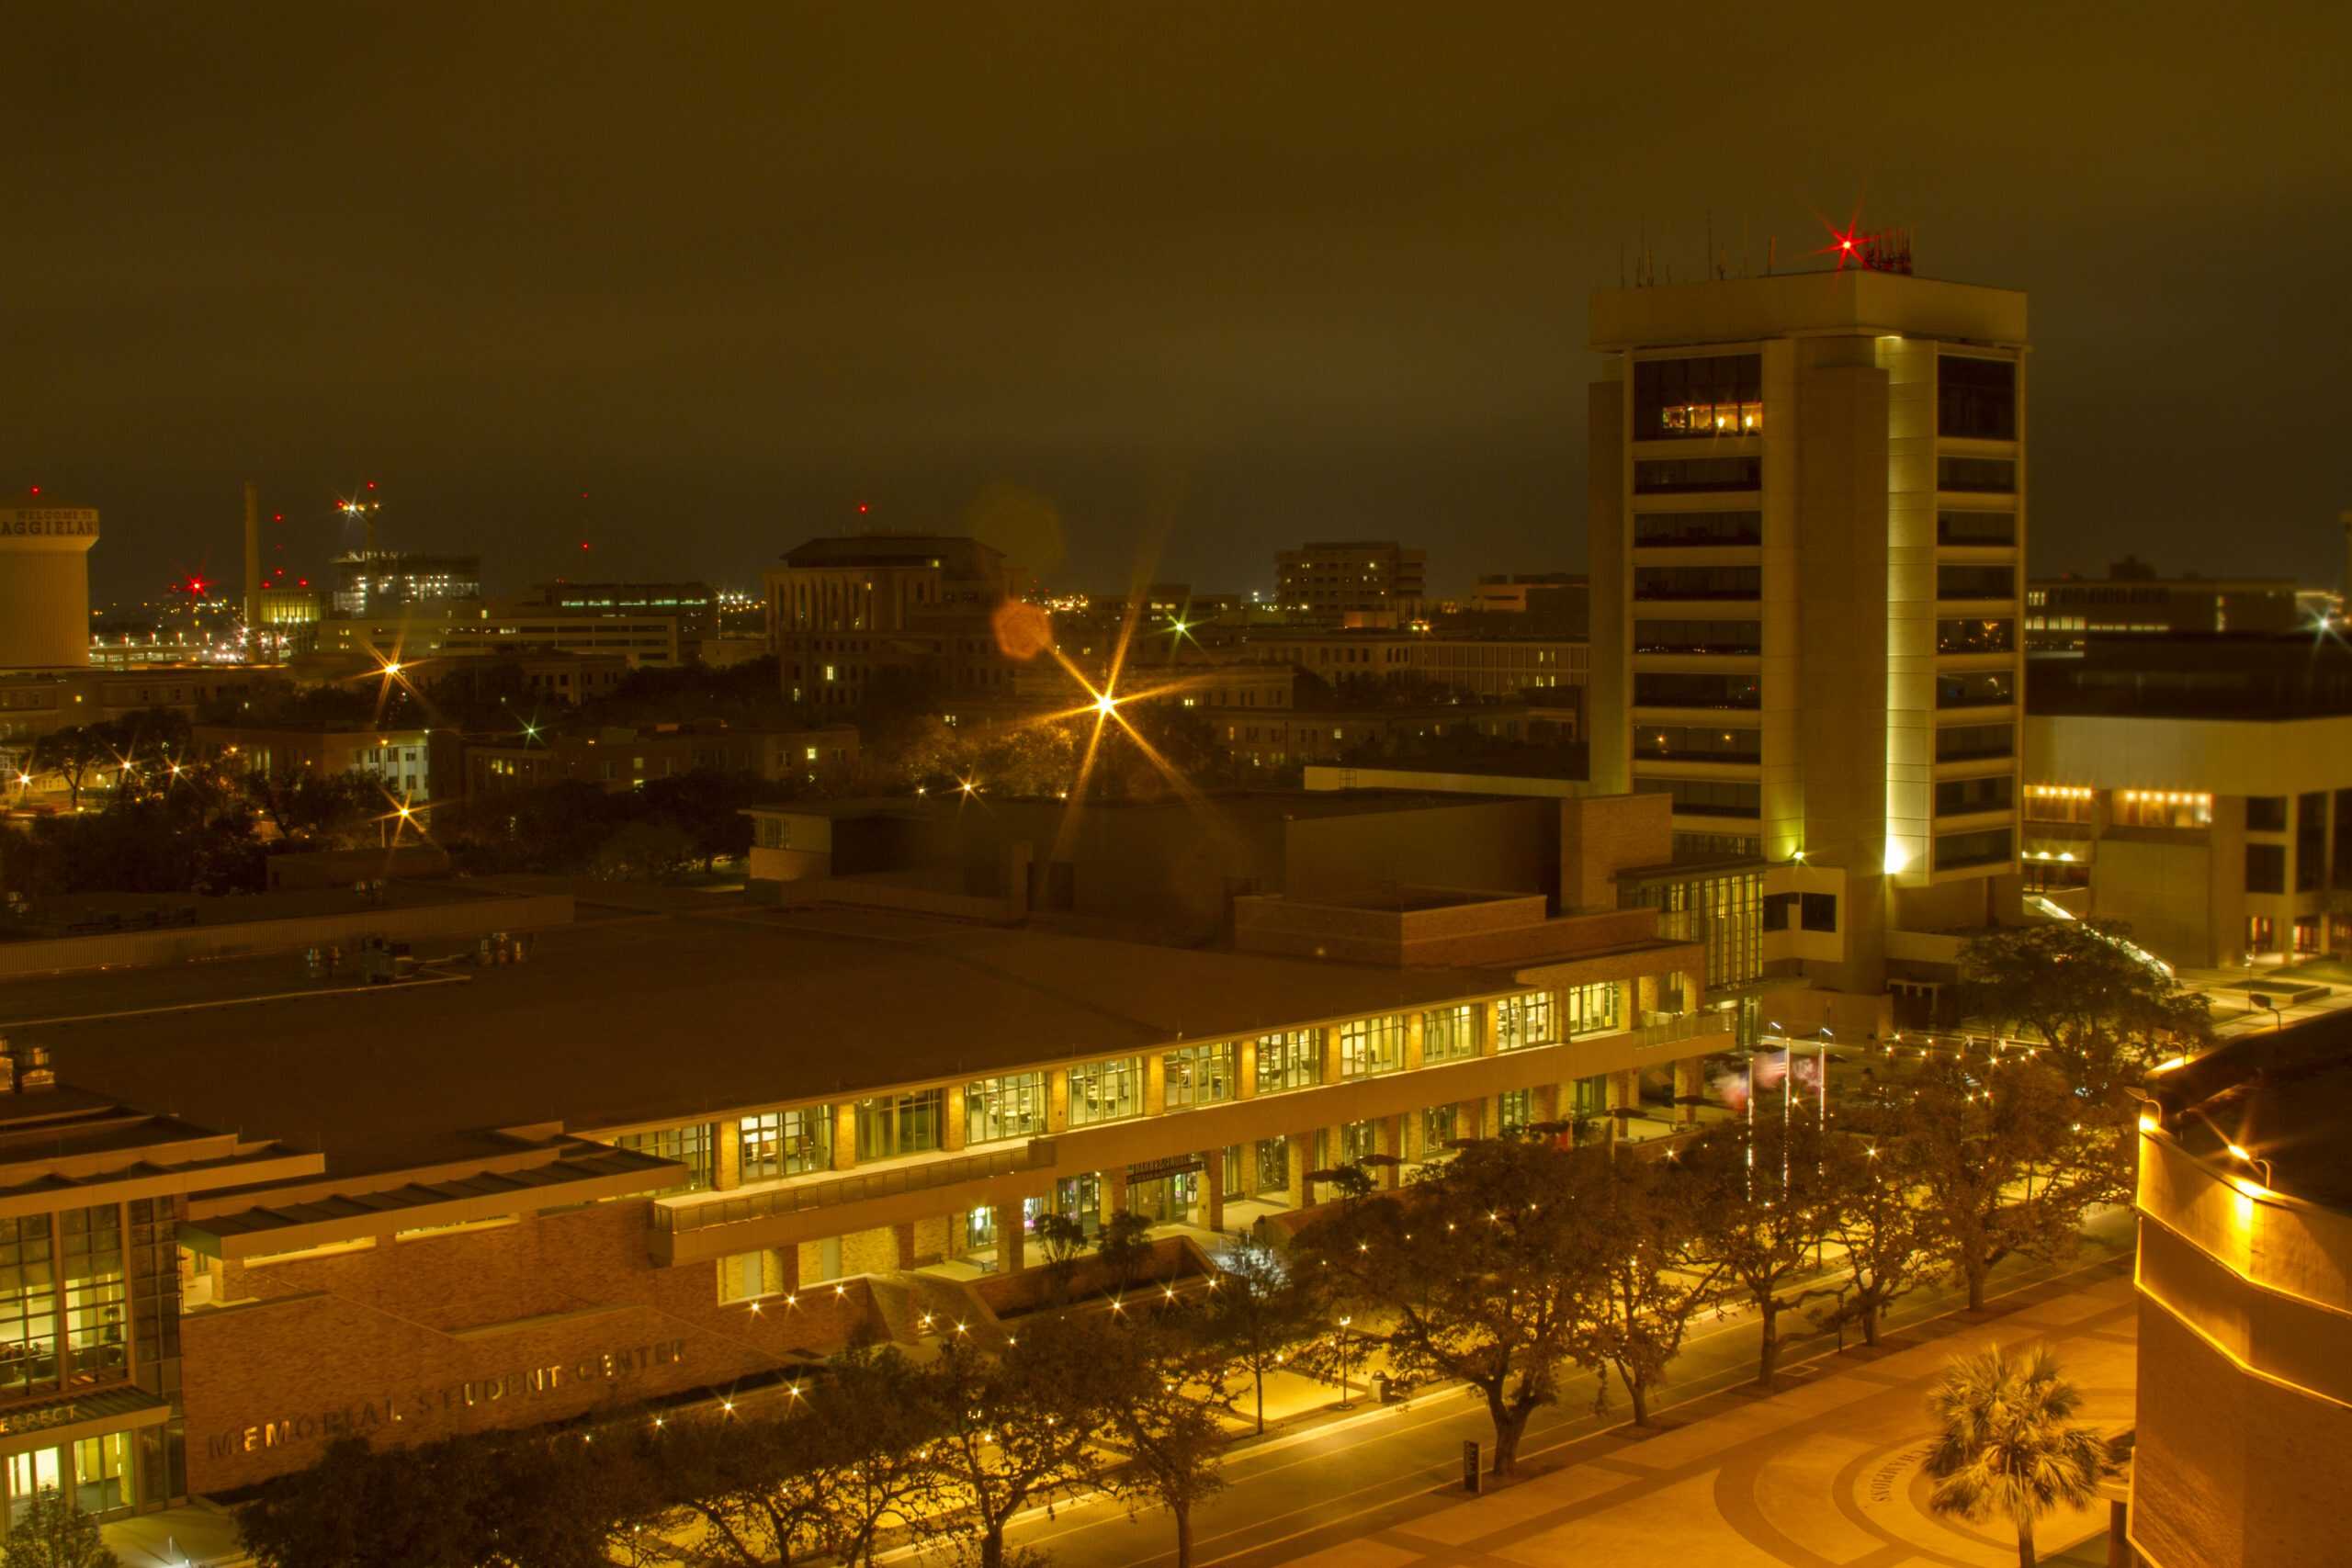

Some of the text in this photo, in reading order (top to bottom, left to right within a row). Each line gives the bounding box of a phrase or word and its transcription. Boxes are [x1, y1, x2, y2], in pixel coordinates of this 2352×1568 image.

[208, 1340, 685, 1458] MEMORIAL STUDENT CENTER
